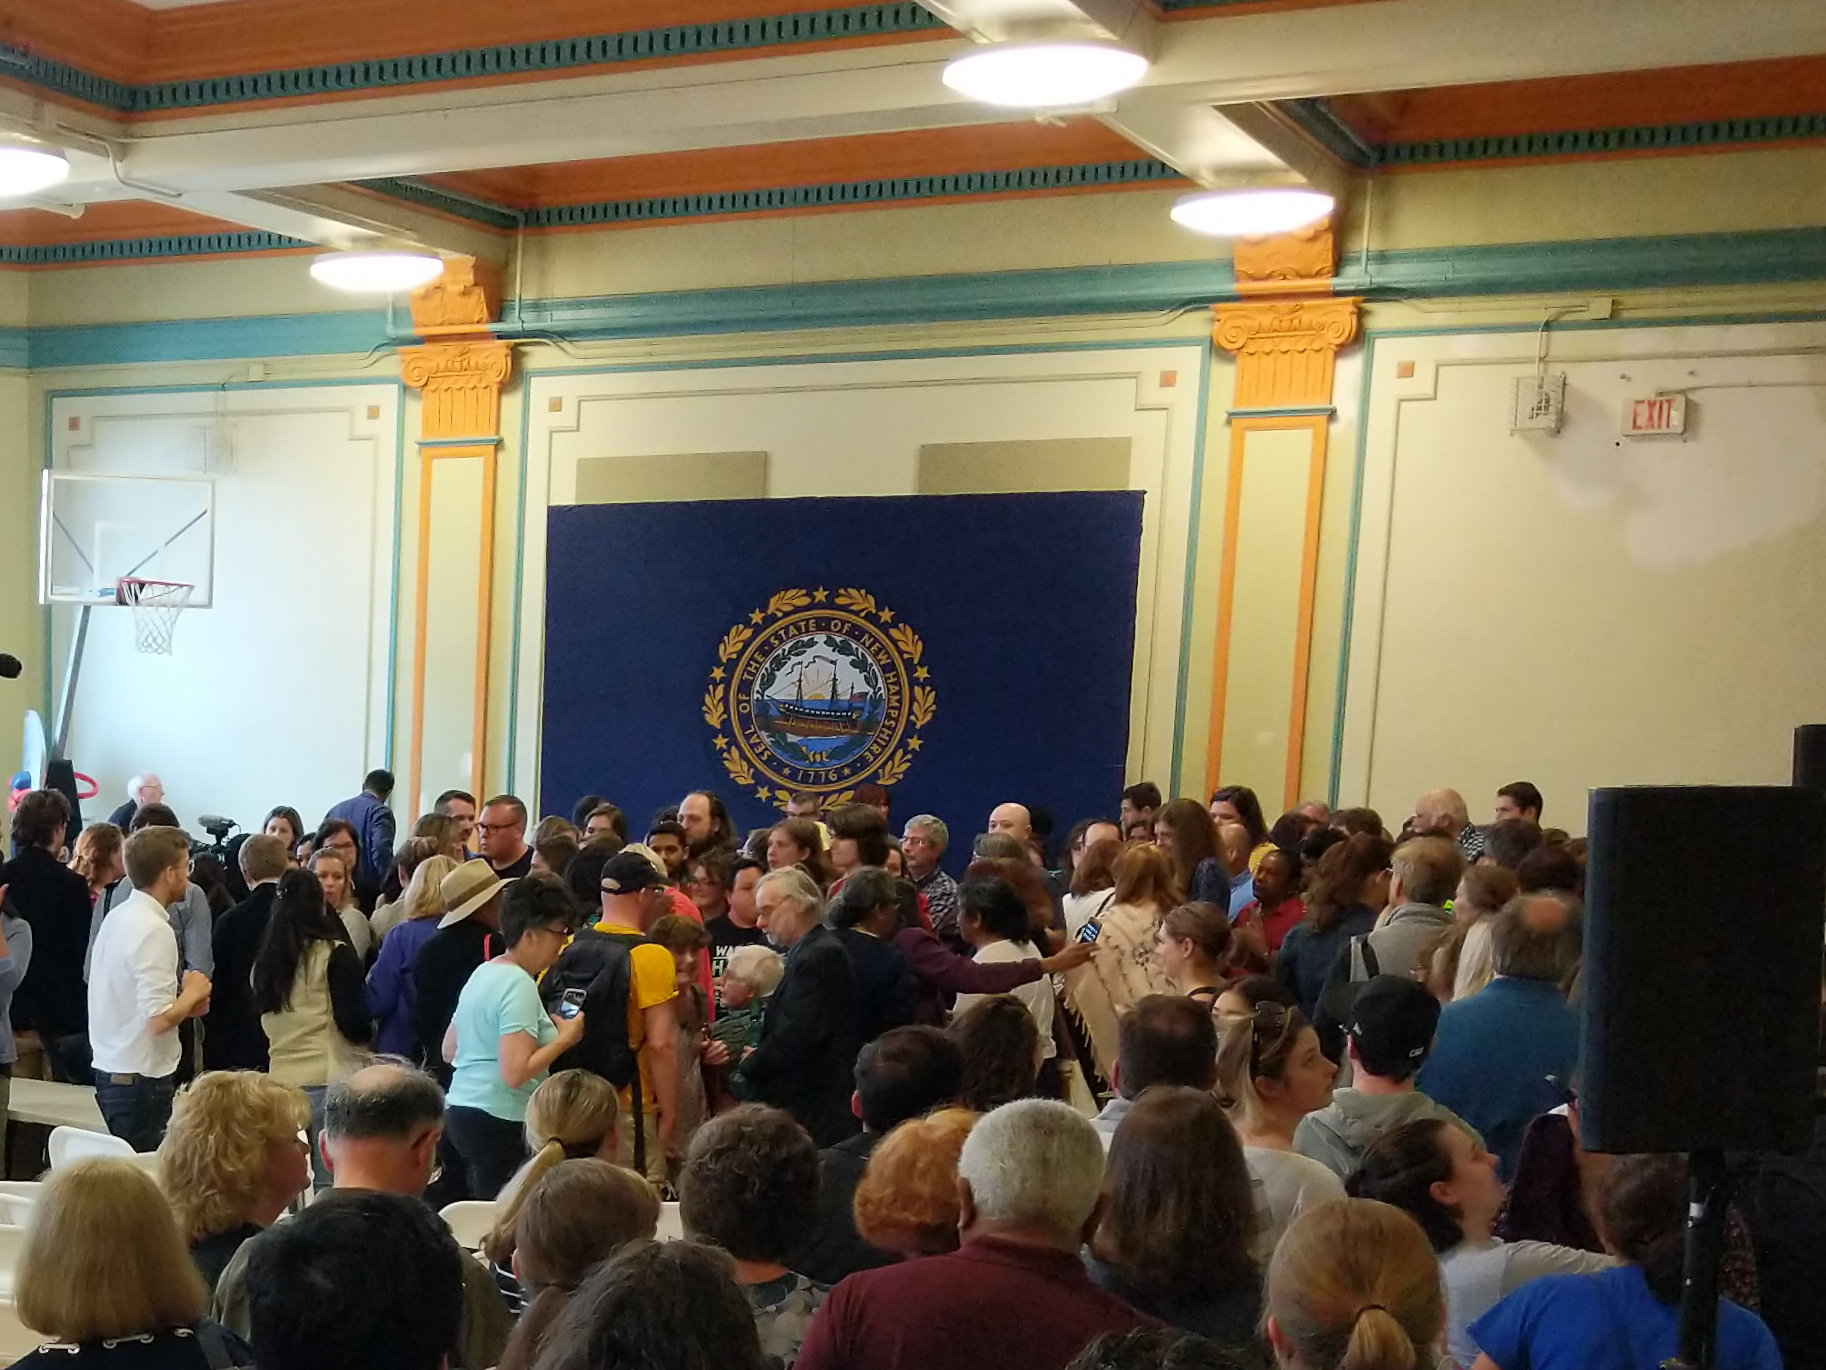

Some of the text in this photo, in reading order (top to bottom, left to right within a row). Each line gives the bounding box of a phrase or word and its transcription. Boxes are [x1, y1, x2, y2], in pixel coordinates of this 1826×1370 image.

[1632, 398, 1673, 430] EXIT
[738, 618, 900, 764] SEAL OF THE STATE OF NEW HAMPSHIRE
[797, 769, 838, 783] 1776
